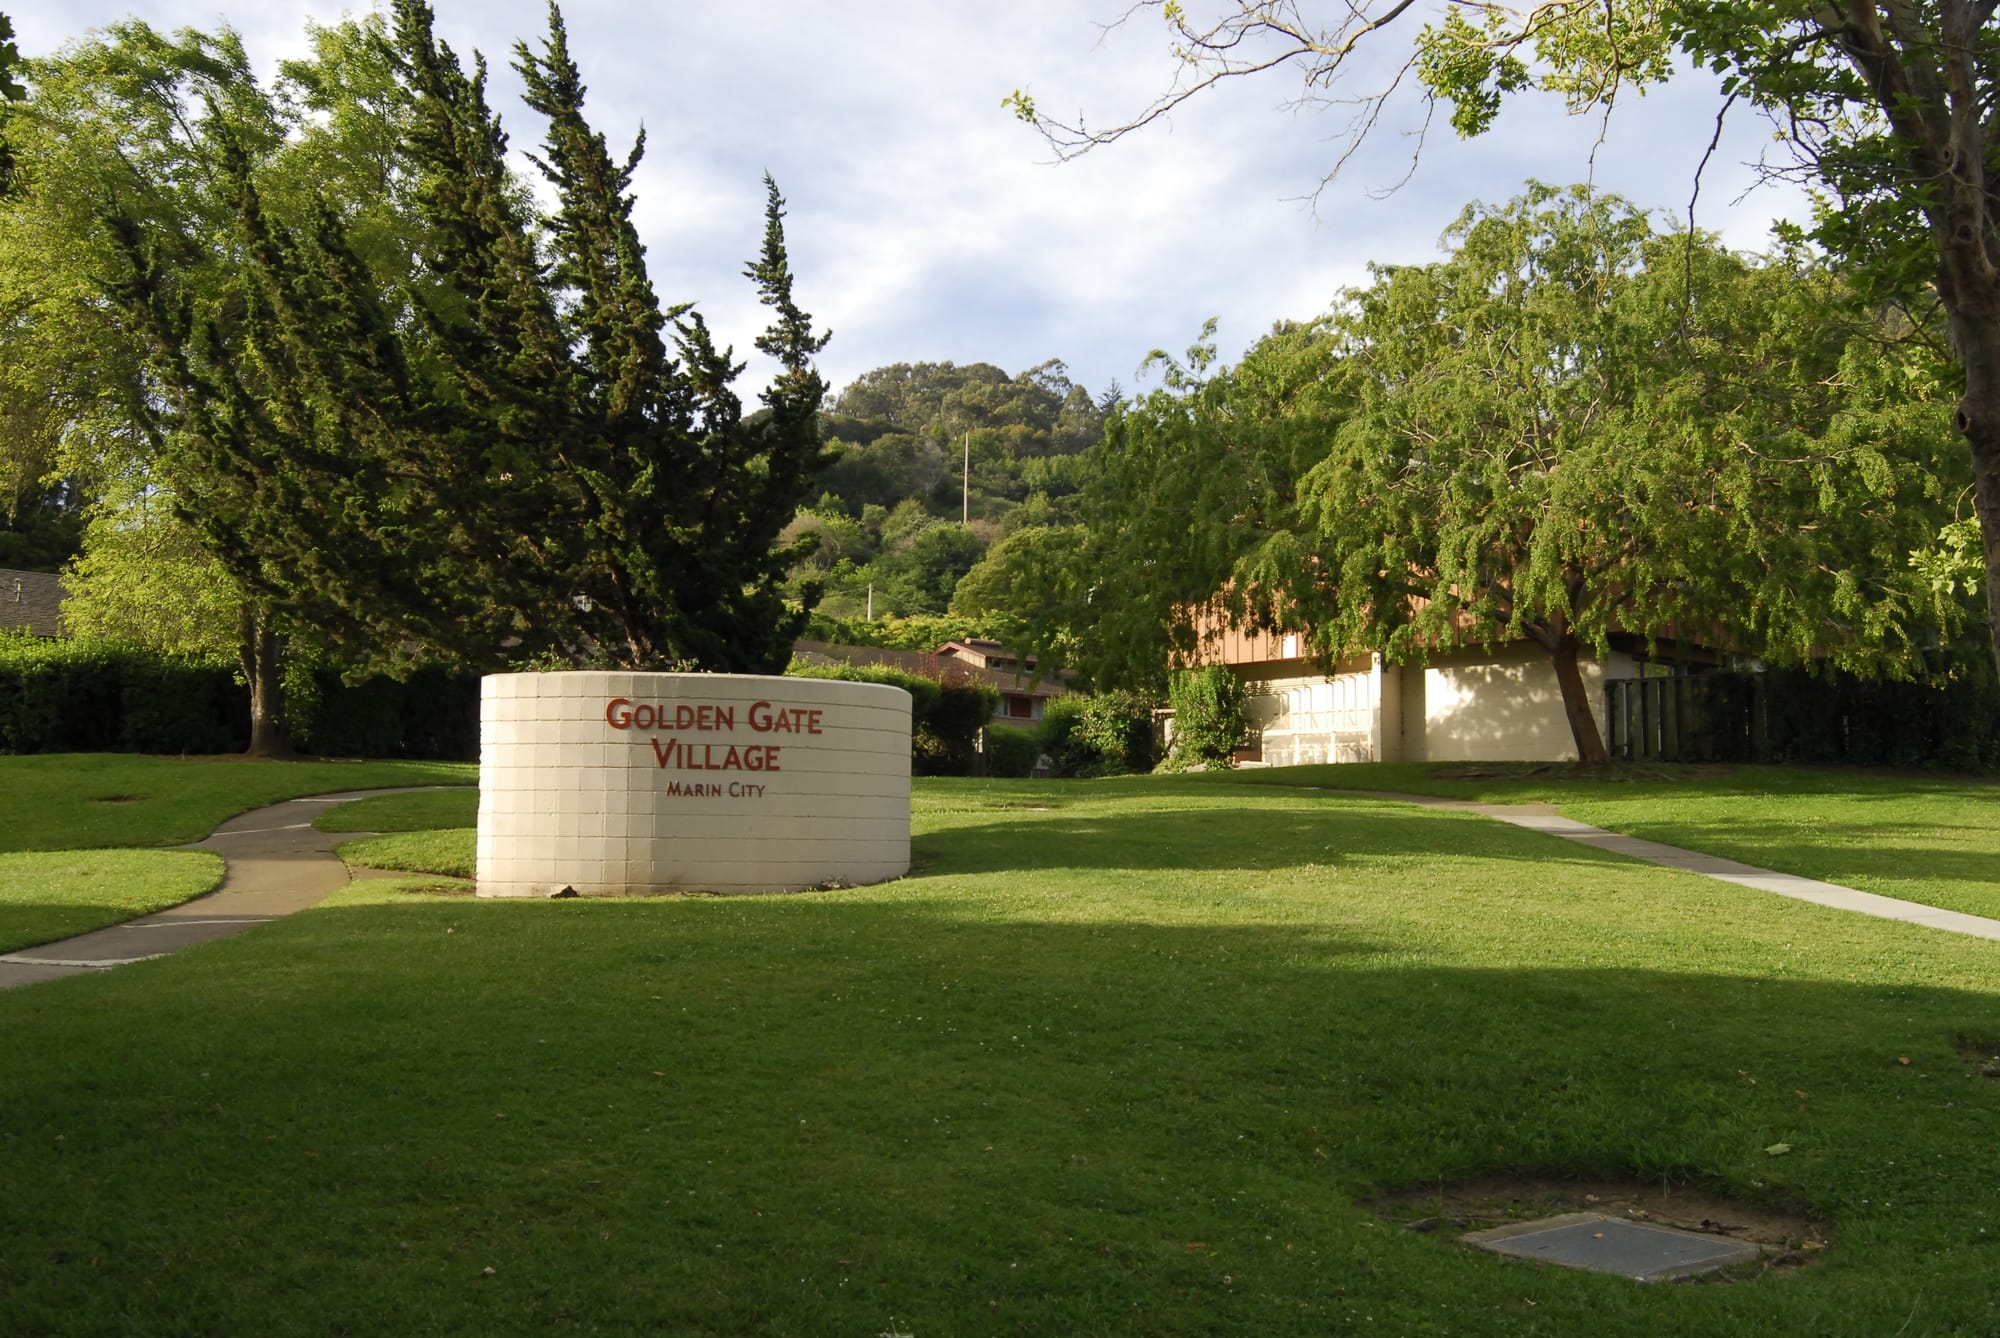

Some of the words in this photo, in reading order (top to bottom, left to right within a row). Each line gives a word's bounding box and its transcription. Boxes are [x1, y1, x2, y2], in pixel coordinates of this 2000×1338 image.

[606, 698, 734, 731] GOLDEN
[749, 701, 823, 734] GATE
[651, 738, 781, 771] VILLAGE
[666, 781, 721, 797] MARIN
[728, 781, 766, 798] CITY
